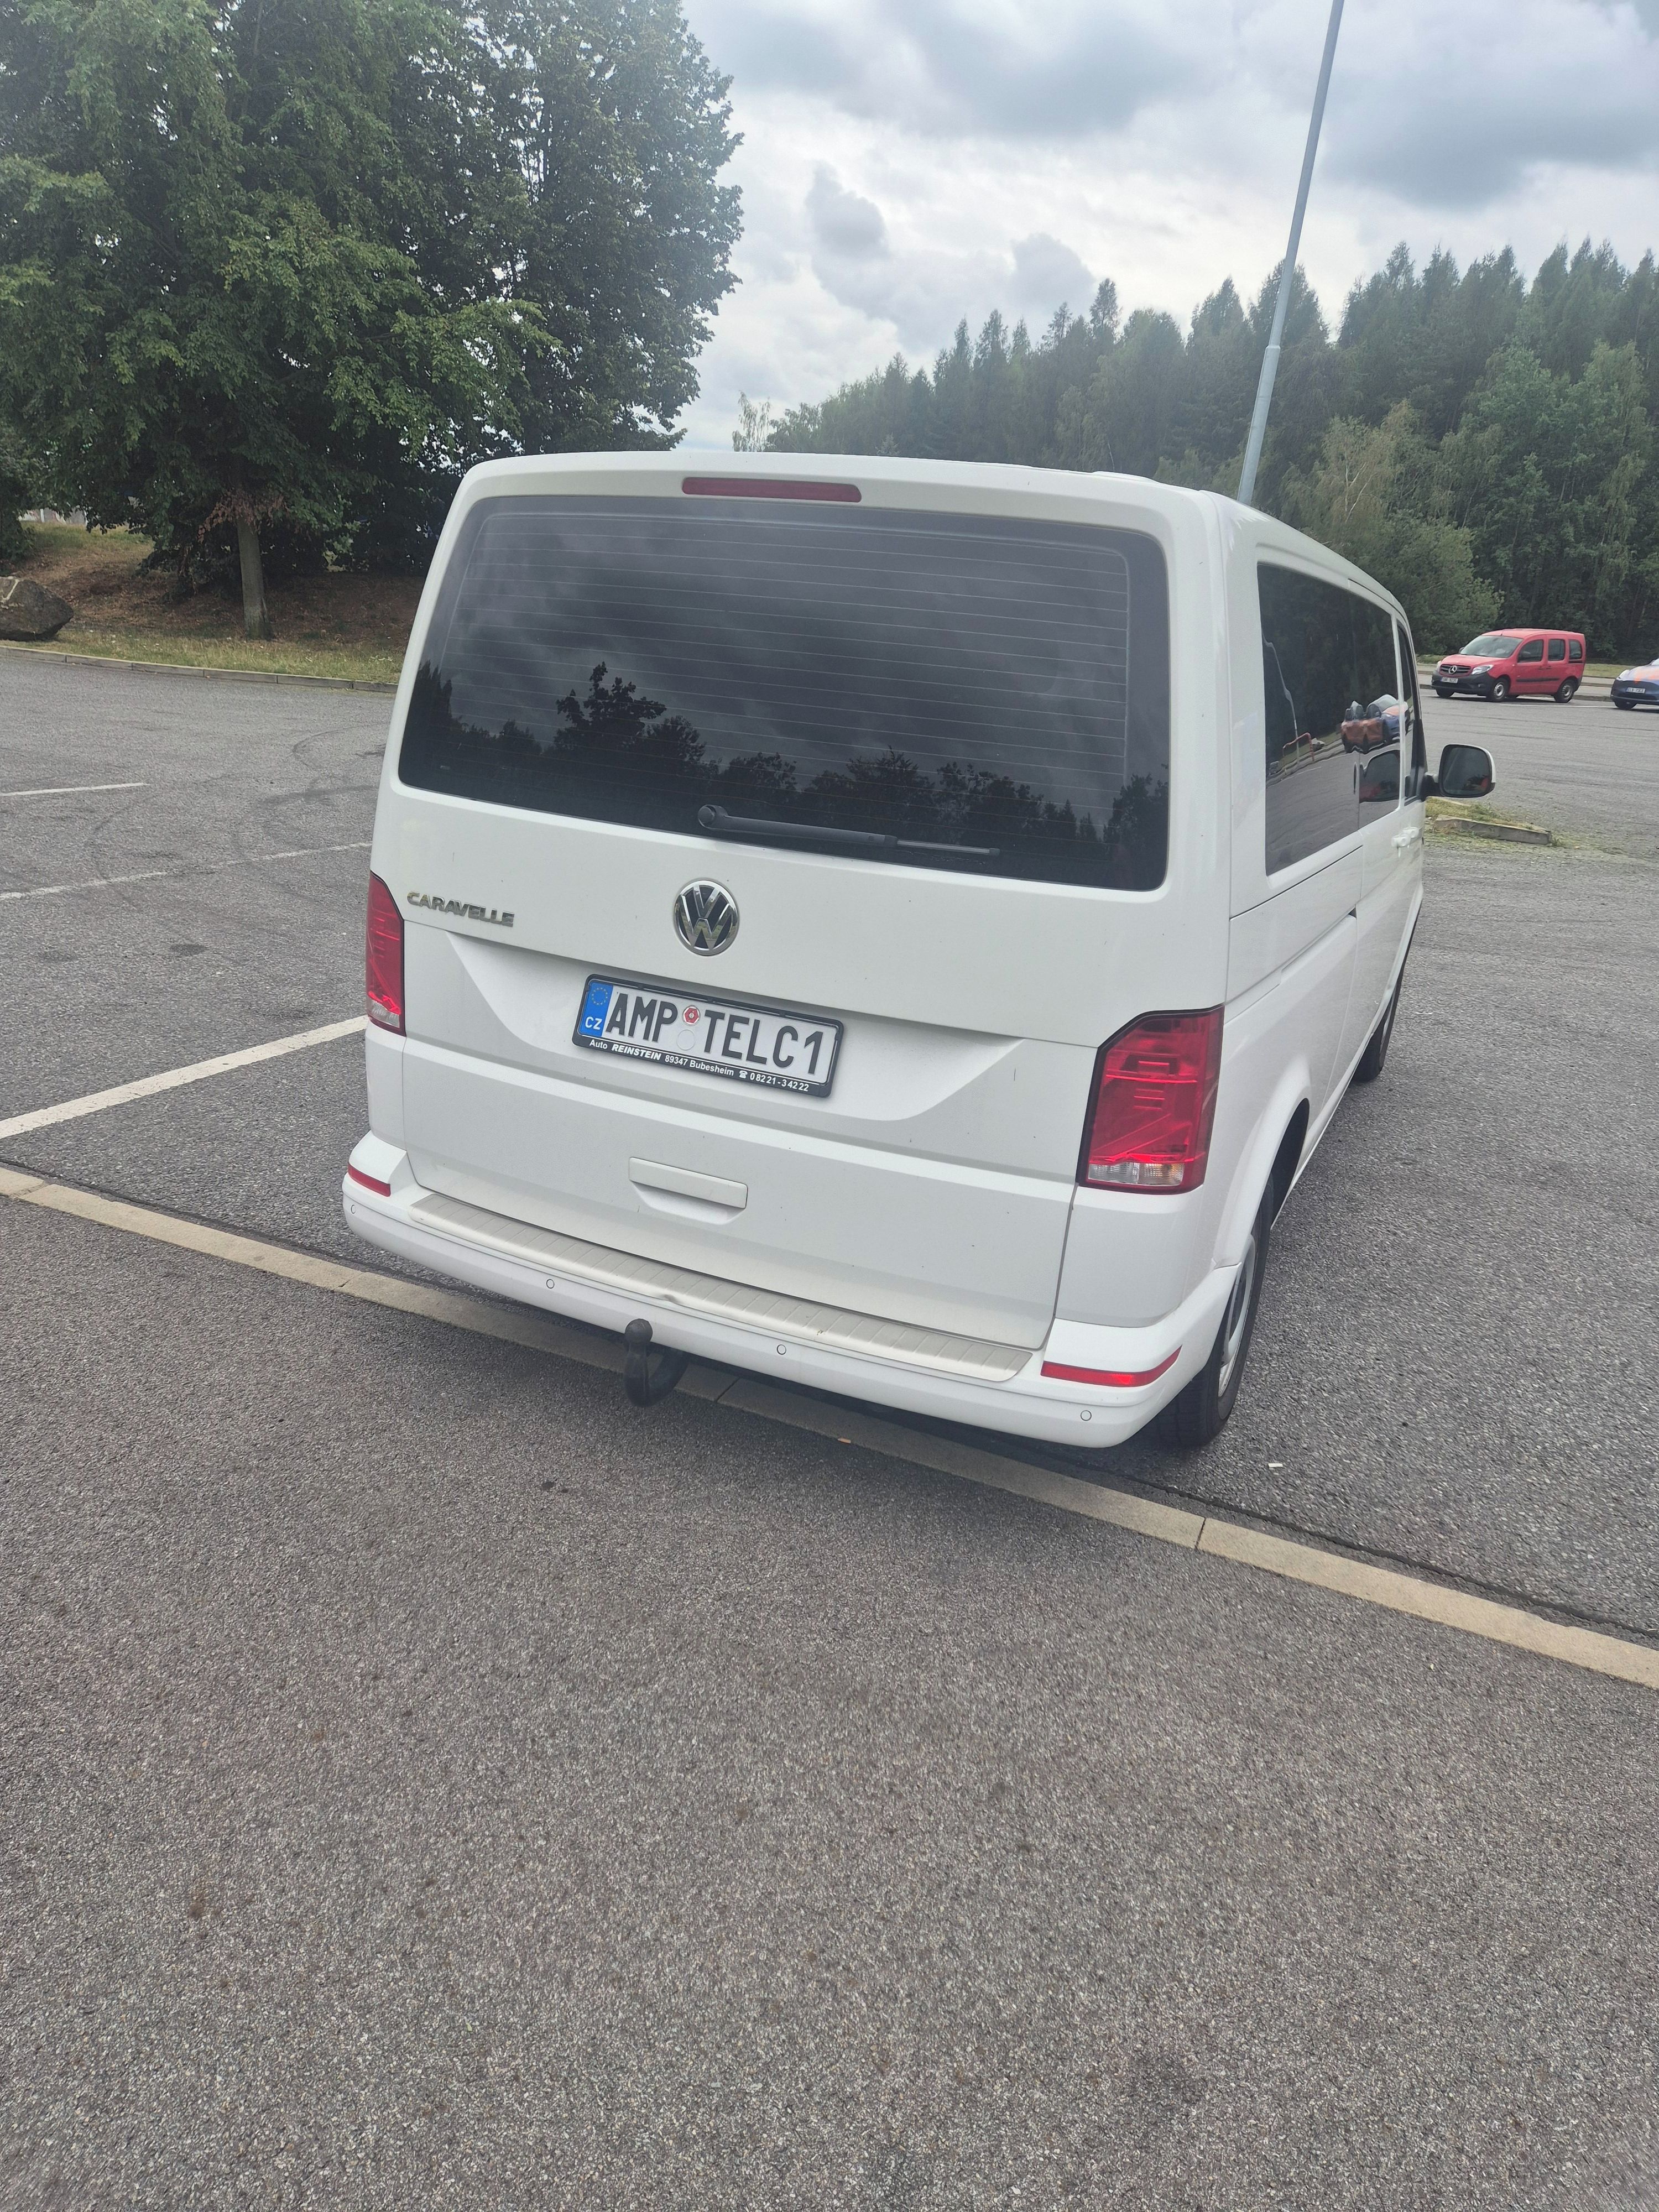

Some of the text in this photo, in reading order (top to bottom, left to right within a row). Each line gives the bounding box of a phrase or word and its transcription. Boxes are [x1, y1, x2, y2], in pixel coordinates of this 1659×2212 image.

[406, 890, 515, 927] CARAVELLE
[585, 1016, 602, 1030] CZ
[606, 993, 823, 1074] AMP TELC1
[589, 1039, 608, 1050] Auto
[612, 1044, 661, 1061] REINSTEIN
[665, 1055, 688, 1067] 89347
[690, 1060, 734, 1077] Bubesheim
